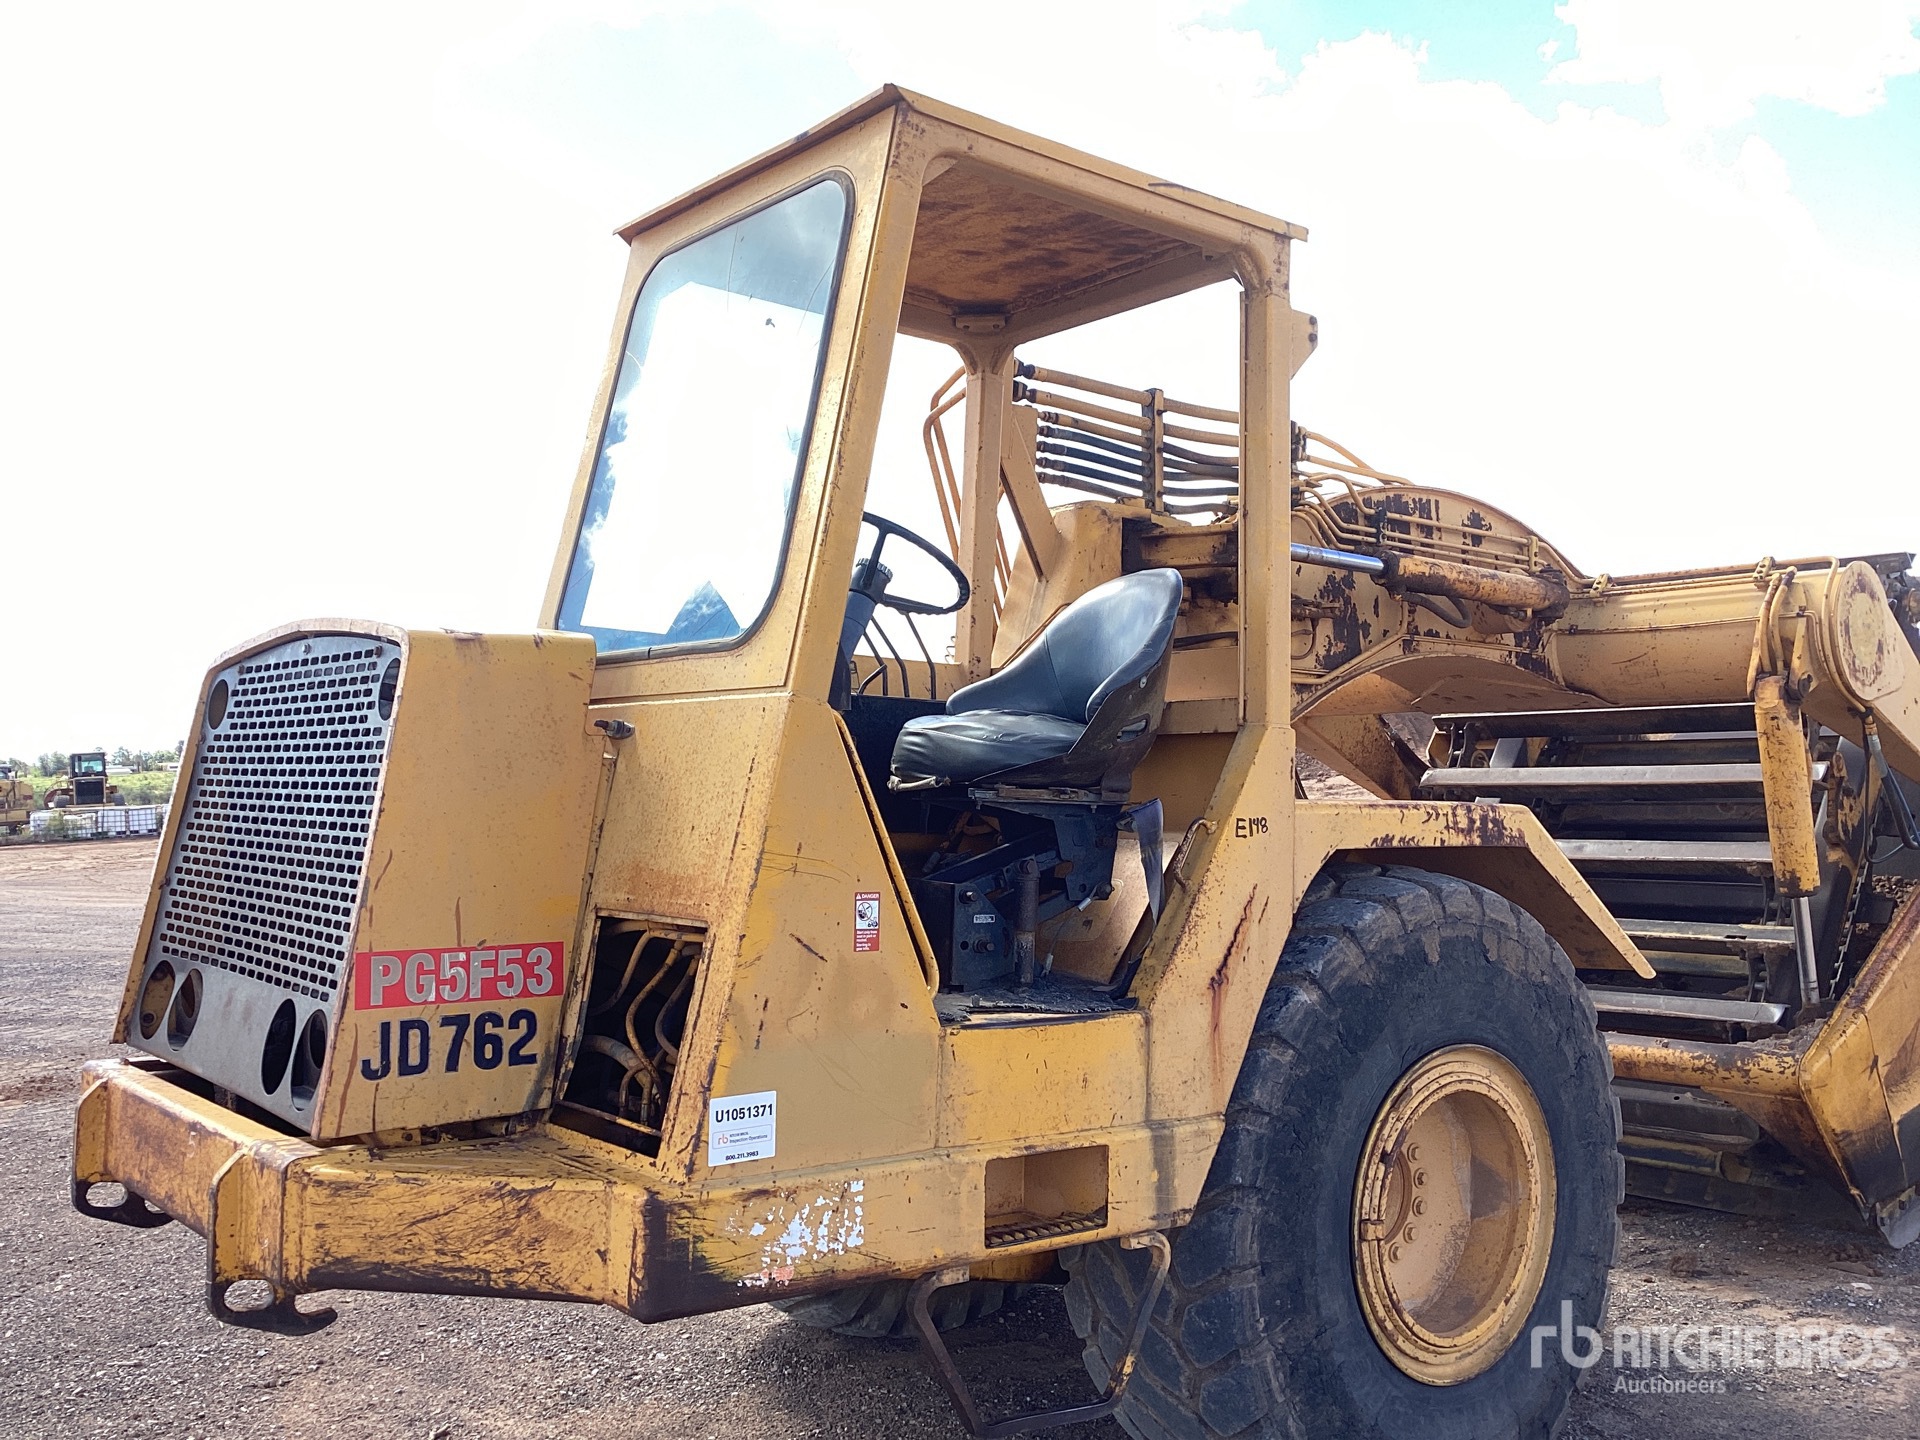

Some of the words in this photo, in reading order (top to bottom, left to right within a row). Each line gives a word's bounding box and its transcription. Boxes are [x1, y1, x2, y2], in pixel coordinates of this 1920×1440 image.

[1235, 816, 1269, 838] E148
[370, 947, 554, 1006] PG5F53
[715, 1103, 773, 1123] U1051371
